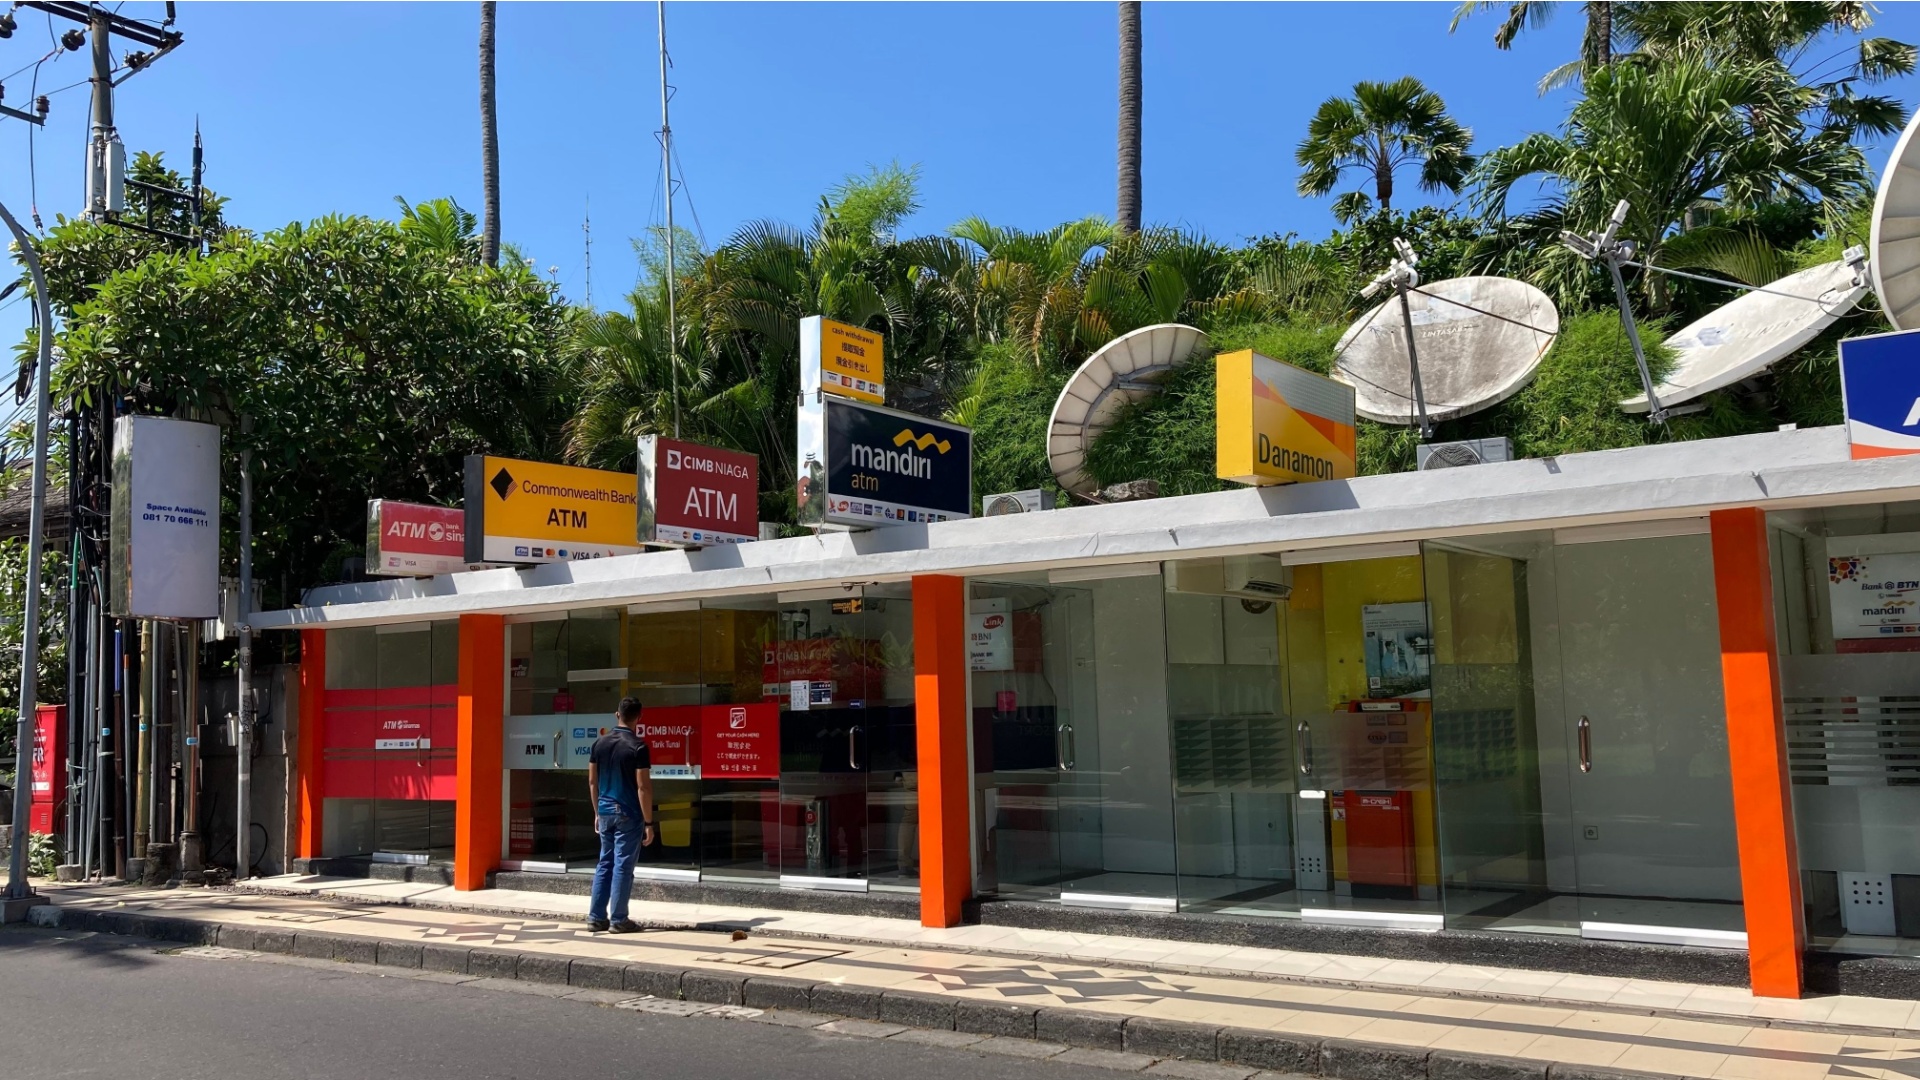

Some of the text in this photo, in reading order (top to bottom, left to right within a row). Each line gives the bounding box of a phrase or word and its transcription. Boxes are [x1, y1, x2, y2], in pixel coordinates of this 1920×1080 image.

[832, 327, 874, 345] cash withdrawal
[851, 443, 931, 479] mandiri
[1258, 432, 1334, 480] Danamon
[683, 456, 749, 479] CIMB NIAGA
[851, 471, 879, 492] atm
[522, 480, 637, 505] Commonwealth Bank
[146, 503, 207, 516] Space Available
[683, 486, 737, 522] ATM
[143, 513, 208, 527] 081 70 666 111
[547, 508, 587, 528] ATM
[387, 521, 426, 539] ATM
[572, 552, 590, 560] VISA
[1861, 581, 1919, 591] Bank BTN
[1862, 606, 1905, 616] mandiri
[984, 616, 1003, 627] Link
[977, 633, 992, 641] BNI
[383, 721, 396, 729] ATM
[646, 725, 667, 736] CIMB
[525, 744, 545, 755] ATM
[575, 746, 591, 755] VISA
